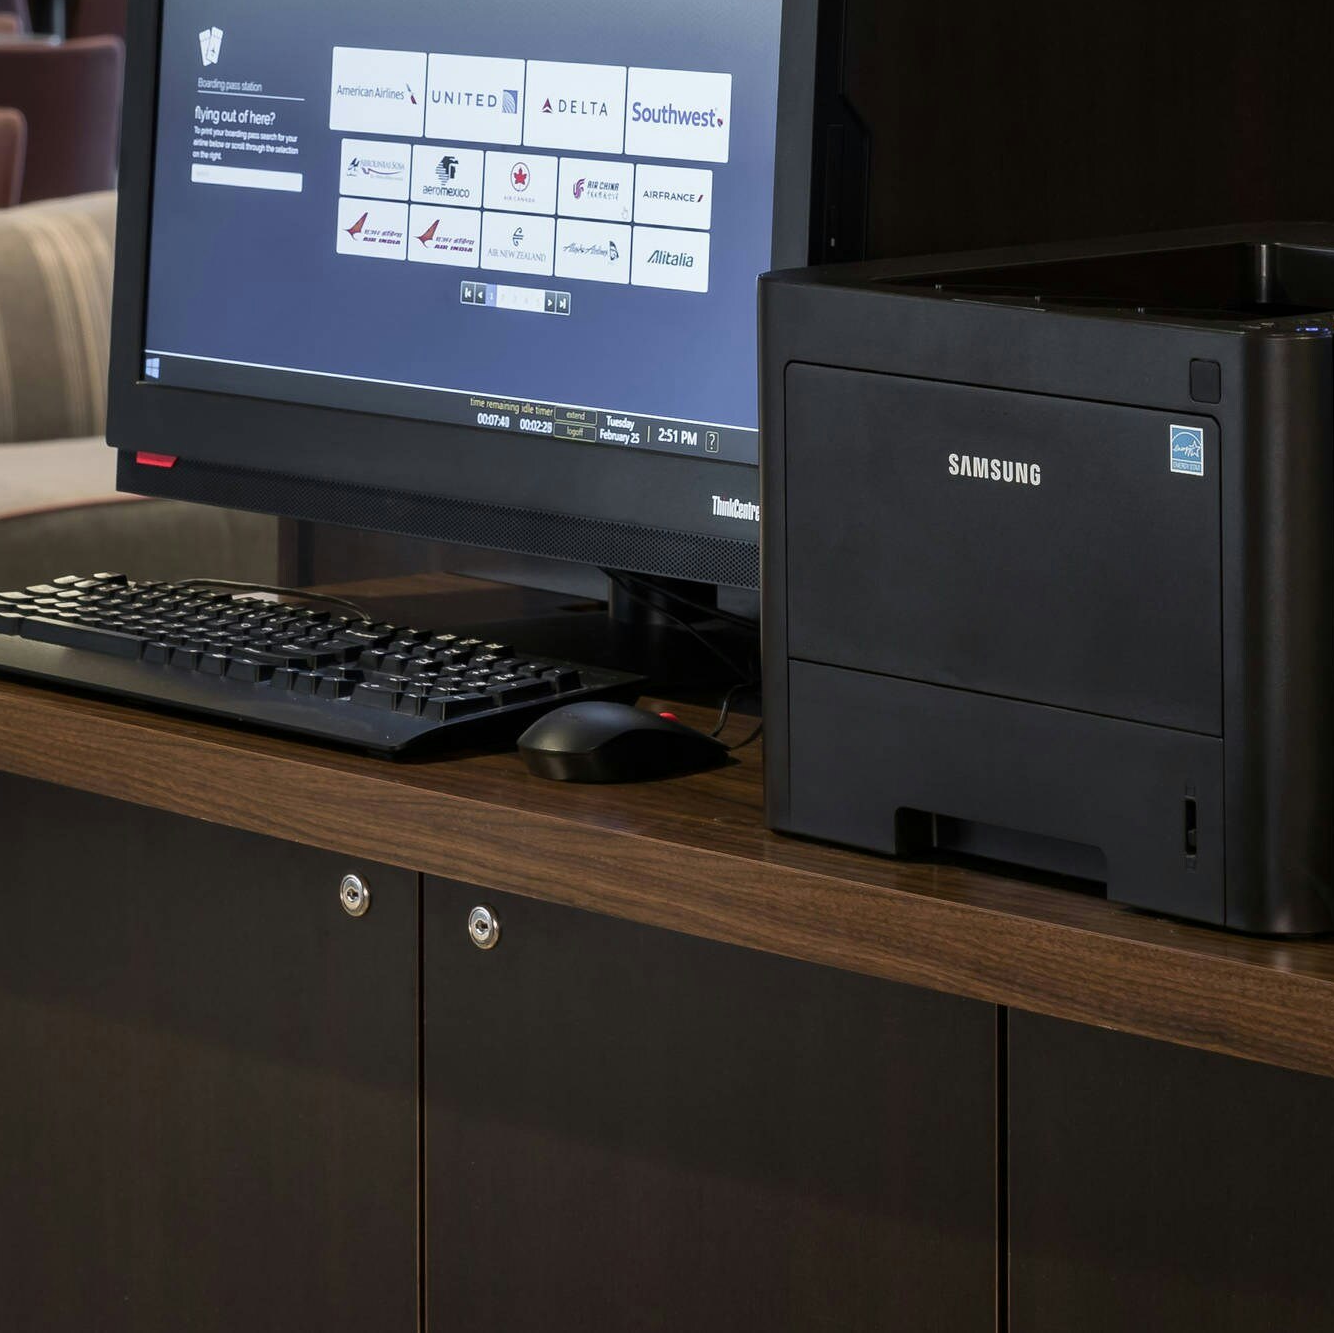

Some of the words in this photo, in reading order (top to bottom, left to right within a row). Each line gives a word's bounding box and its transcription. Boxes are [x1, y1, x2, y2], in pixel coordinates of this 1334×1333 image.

[197, 77, 225, 92] Boarding
[226, 82, 241, 91] pass
[241, 81, 262, 92] station
[337, 84, 374, 97] American
[374, 86, 404, 100] Airlines
[431, 89, 497, 108] UNITED
[195, 105, 220, 125] flying
[221, 109, 237, 123] out
[238, 109, 249, 123] of
[249, 110, 276, 125] here?
[558, 99, 608, 116] DELTA
[632, 101, 716, 127] Southwest
[422, 185, 470, 199] aeromexico
[450, 245, 473, 253] INDIA
[487, 248, 499, 257] AIR
[499, 249, 515, 259] NEW
[515, 250, 546, 262] ZEALAND
[647, 249, 694, 268] Alitalia
[470, 396, 485, 408] time
[486, 400, 520, 415] remaining
[521, 403, 534, 414] idle
[535, 405, 553, 417] timer
[606, 415, 635, 432] Tuesday
[599, 428, 630, 445] February
[630, 432, 640, 444] 25
[657, 427, 678, 444] 2:51
[681, 430, 698, 446] PM
[947, 452, 1042, 486] SAMSUNG
[711, 495, 760, 521] ThinkCentre
